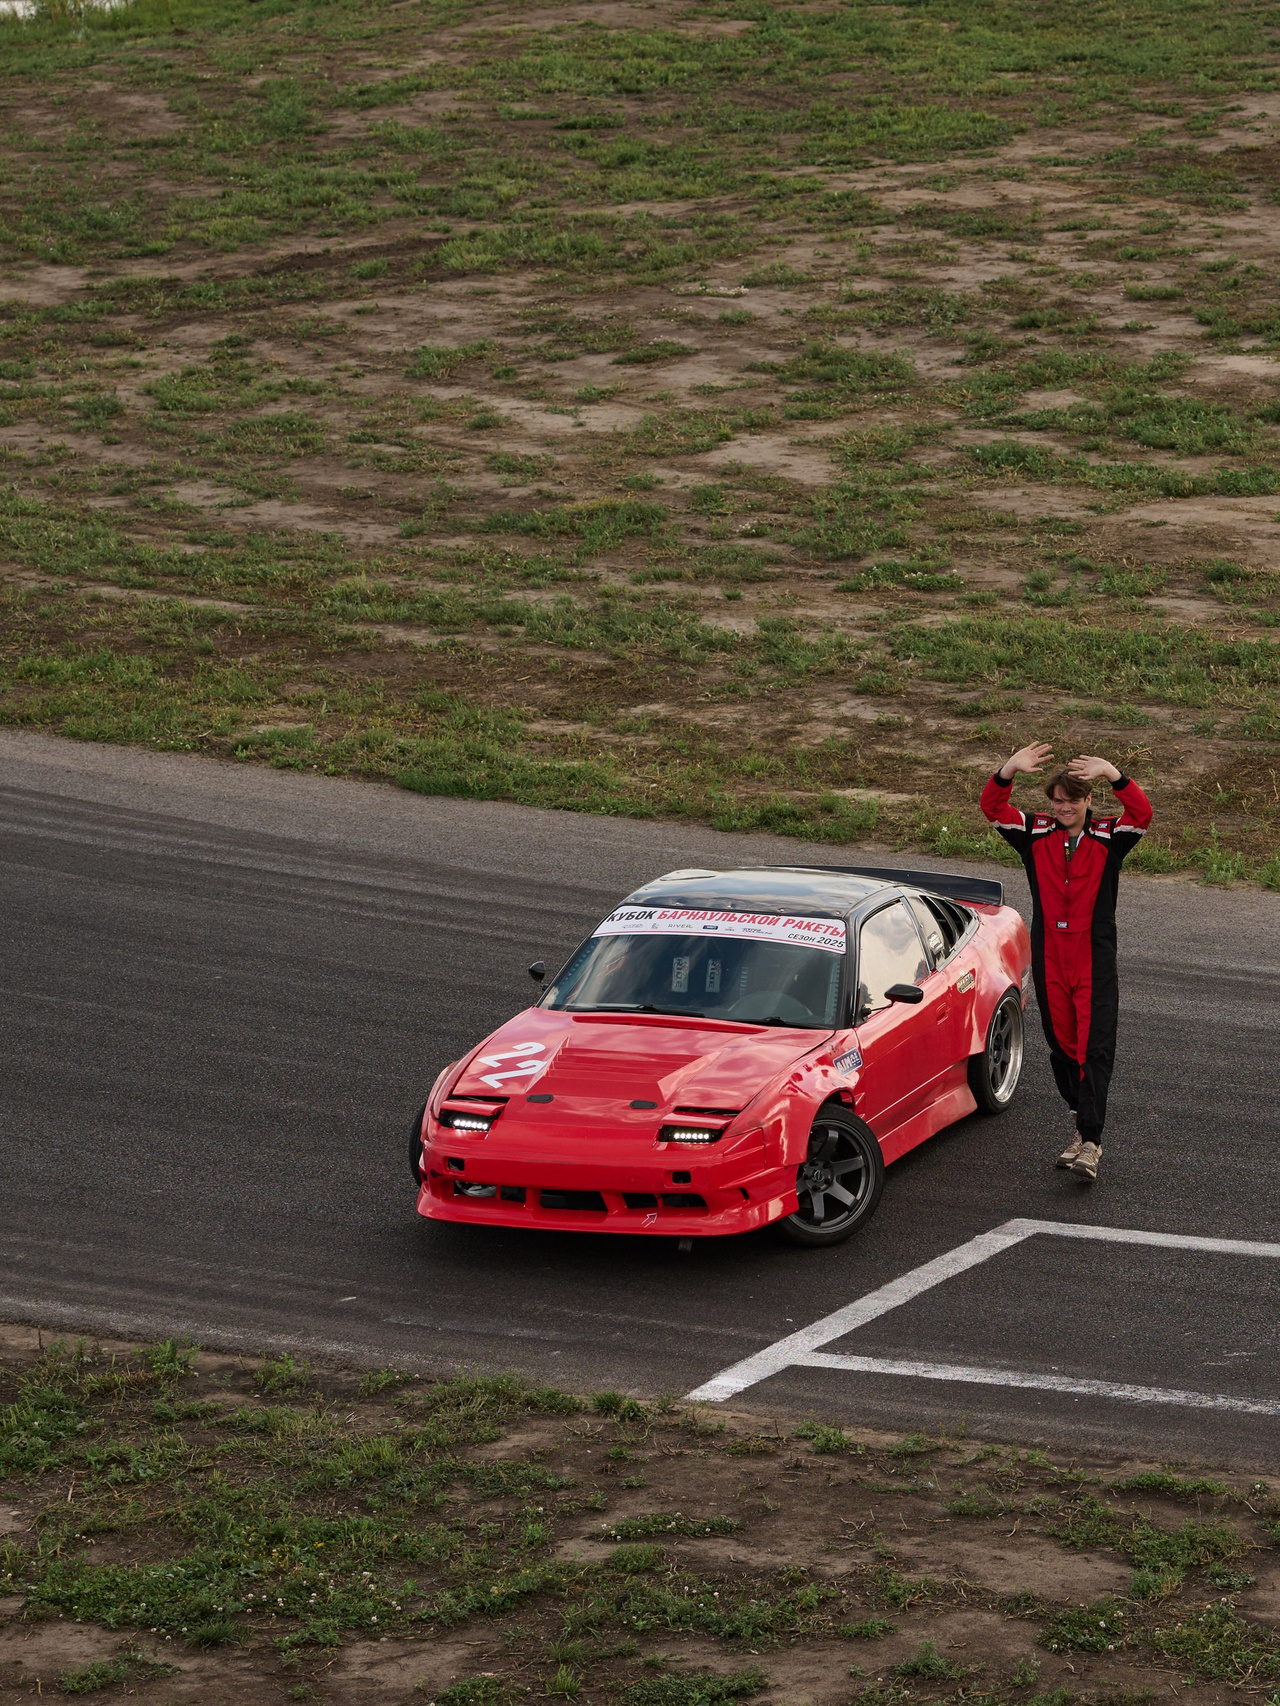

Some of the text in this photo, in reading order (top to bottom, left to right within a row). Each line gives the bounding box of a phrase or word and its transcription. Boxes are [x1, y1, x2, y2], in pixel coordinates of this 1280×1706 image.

[606, 911, 657, 922] КУБОК
[657, 910, 782, 927] БАРНАУЛЬСКОЙ
[782, 918, 847, 938] РАКЕТЫ
[787, 933, 846, 948] СЕЗОН 2025
[477, 1041, 548, 1089] 22
